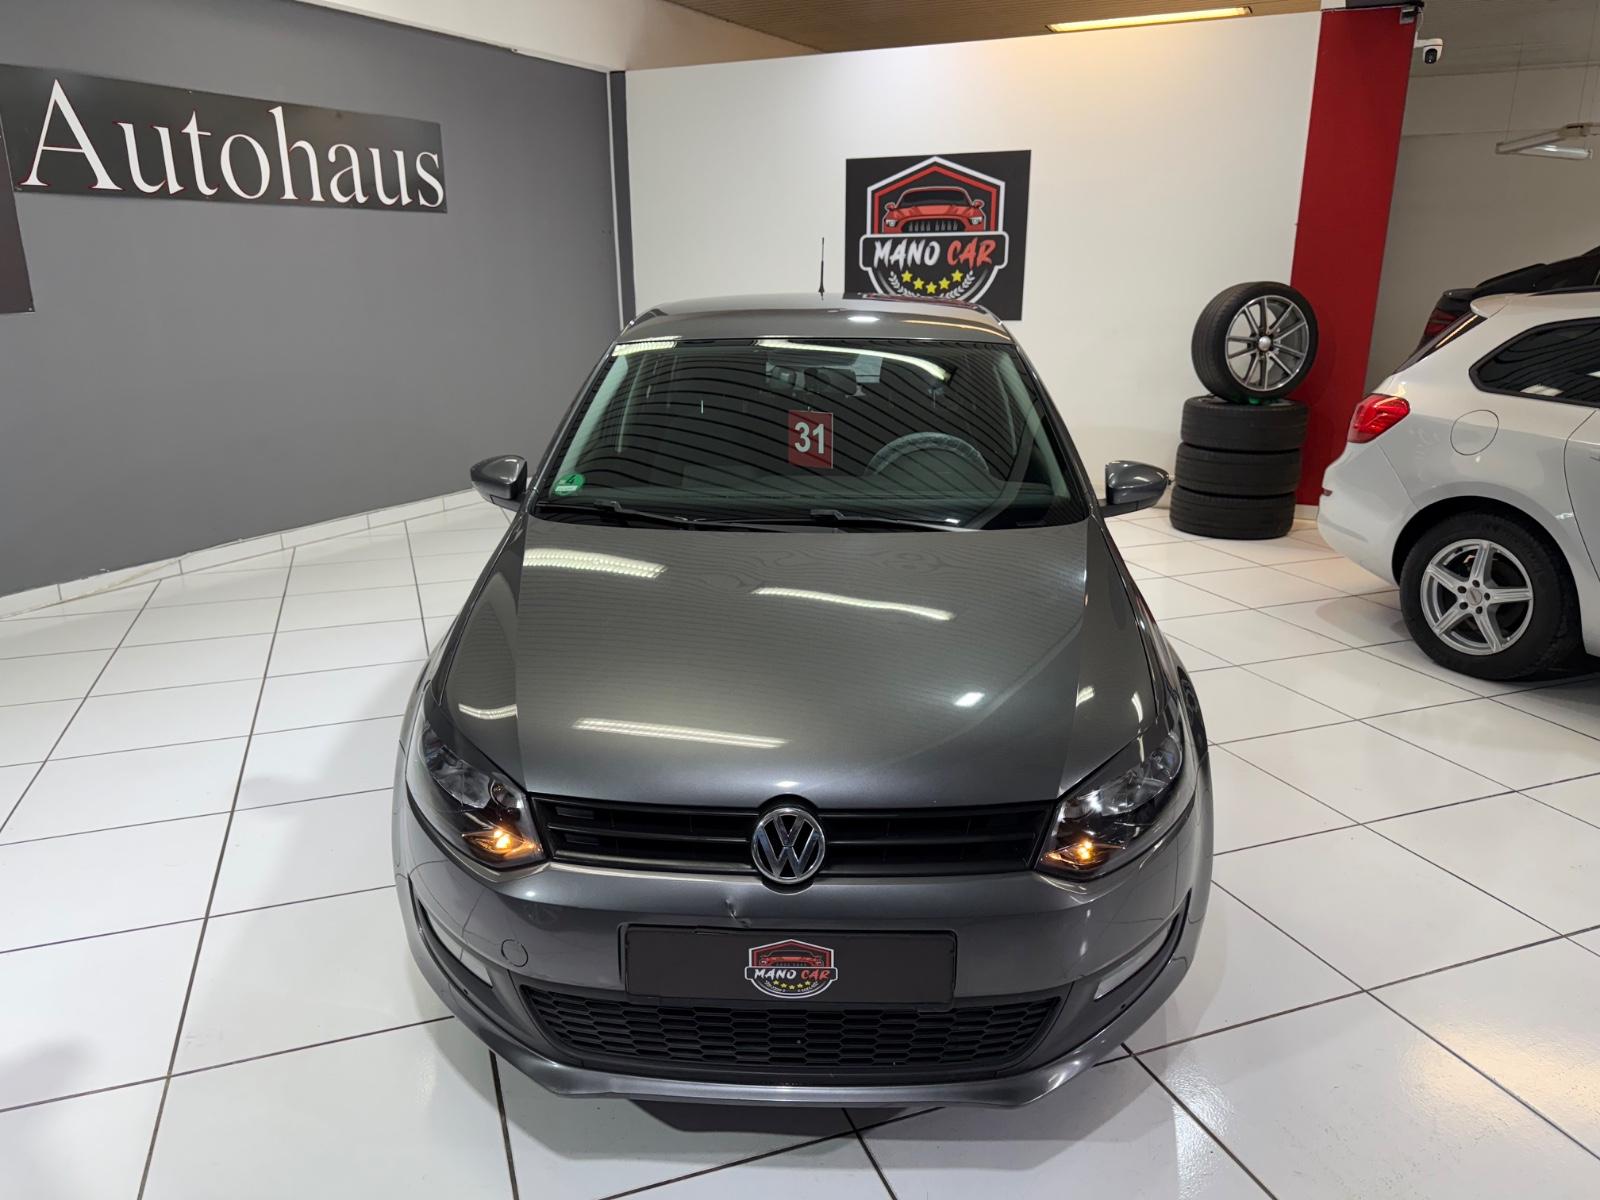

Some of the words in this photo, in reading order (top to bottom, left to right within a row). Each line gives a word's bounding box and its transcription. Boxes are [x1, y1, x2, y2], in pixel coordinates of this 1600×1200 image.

[19, 79, 445, 208] Autohaus
[873, 238, 941, 271] MANO
[946, 237, 997, 271] CAR
[794, 421, 825, 455] 31
[565, 474, 577, 485] 4
[754, 968, 797, 980] MANO
[800, 968, 832, 981] CAR
